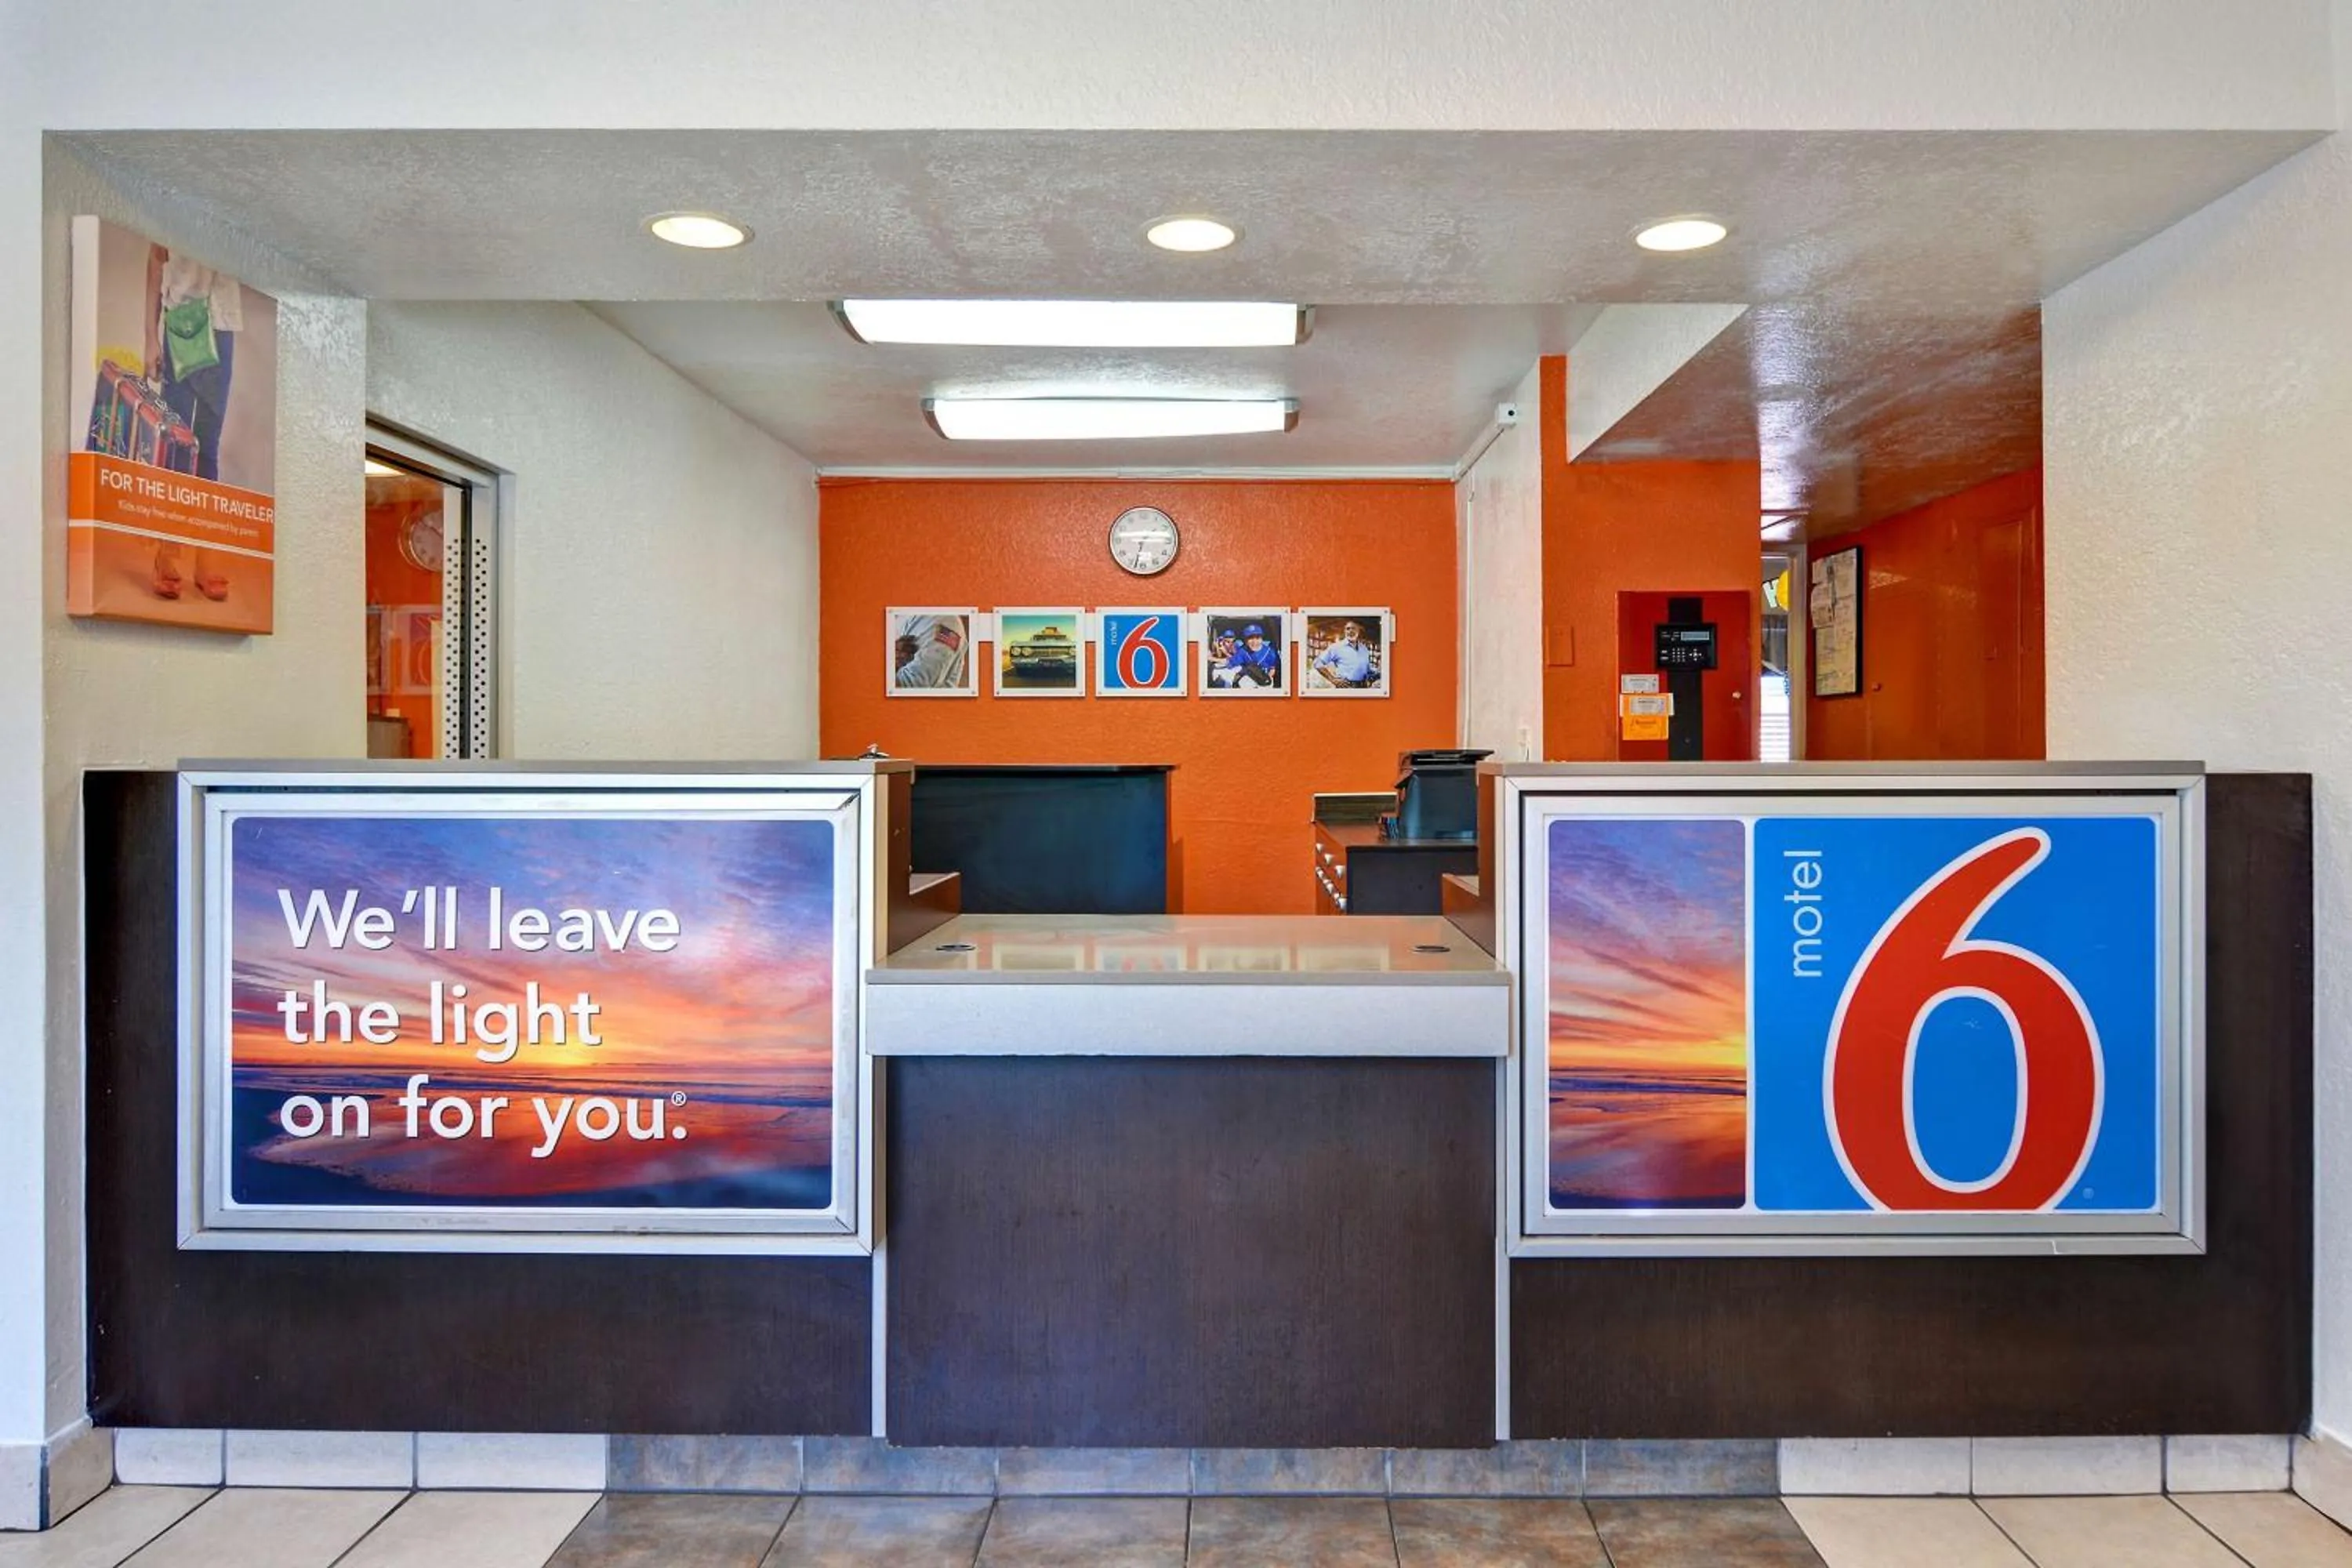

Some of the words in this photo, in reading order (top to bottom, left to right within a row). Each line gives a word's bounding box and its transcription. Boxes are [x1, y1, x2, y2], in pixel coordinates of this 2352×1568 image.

[101, 469, 132, 493] FOR
[136, 476, 165, 499] THE
[169, 483, 209, 510] LIGHT
[212, 495, 274, 524] TRAVELER
[1116, 616, 1170, 688] 6
[489, 887, 680, 952] leave
[1784, 850, 1823, 978] motel
[278, 980, 400, 1044] the
[430, 981, 602, 1062] light
[1823, 826, 2104, 1212] 6
[280, 1094, 370, 1138] on
[398, 1074, 509, 1138] for
